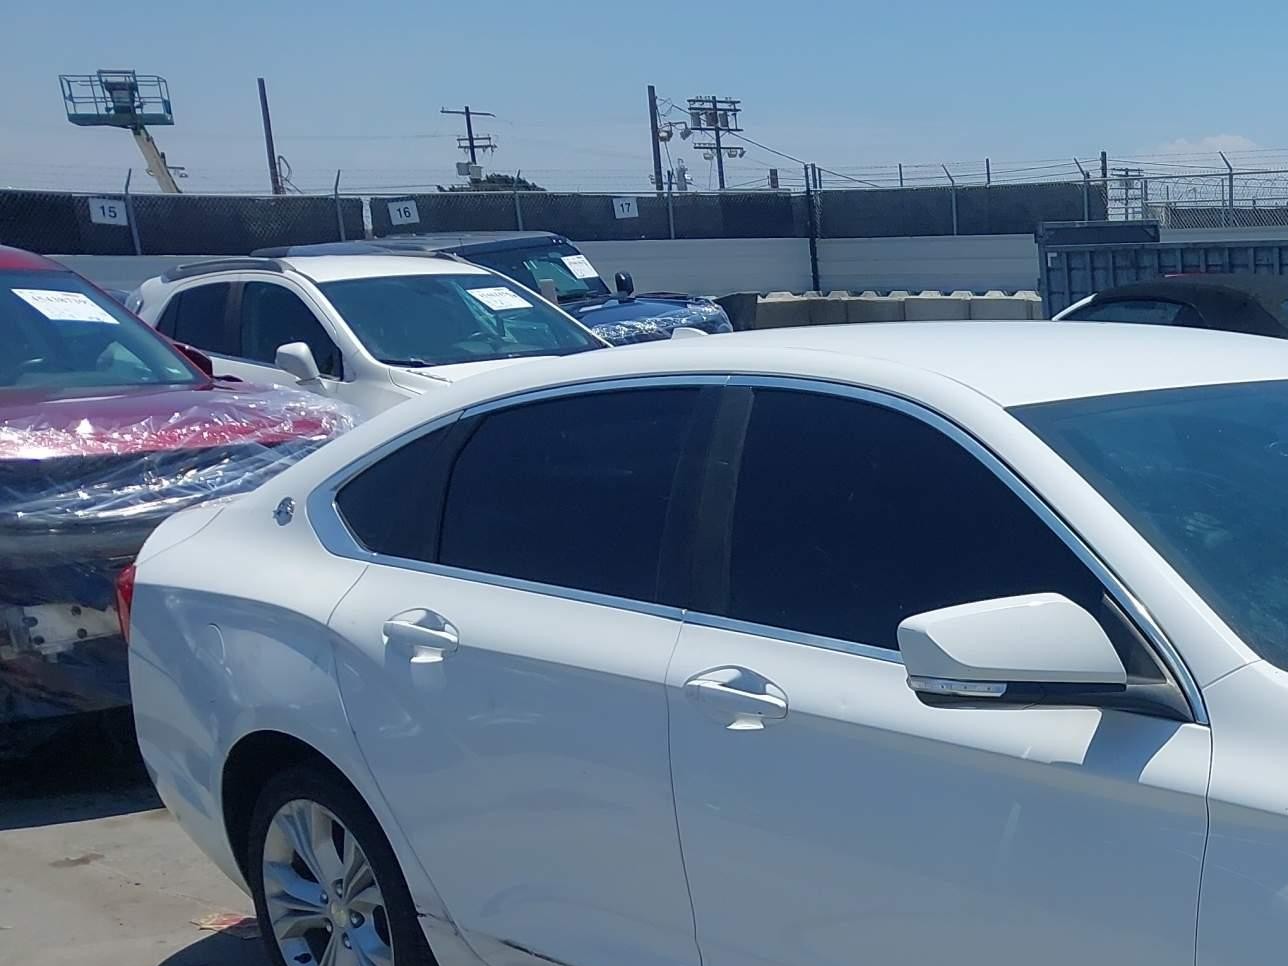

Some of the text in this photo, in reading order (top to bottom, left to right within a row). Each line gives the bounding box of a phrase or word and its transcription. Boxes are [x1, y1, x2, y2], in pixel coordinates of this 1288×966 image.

[100, 204, 117, 218] 15
[396, 206, 411, 219] 16
[620, 202, 631, 214] 17
